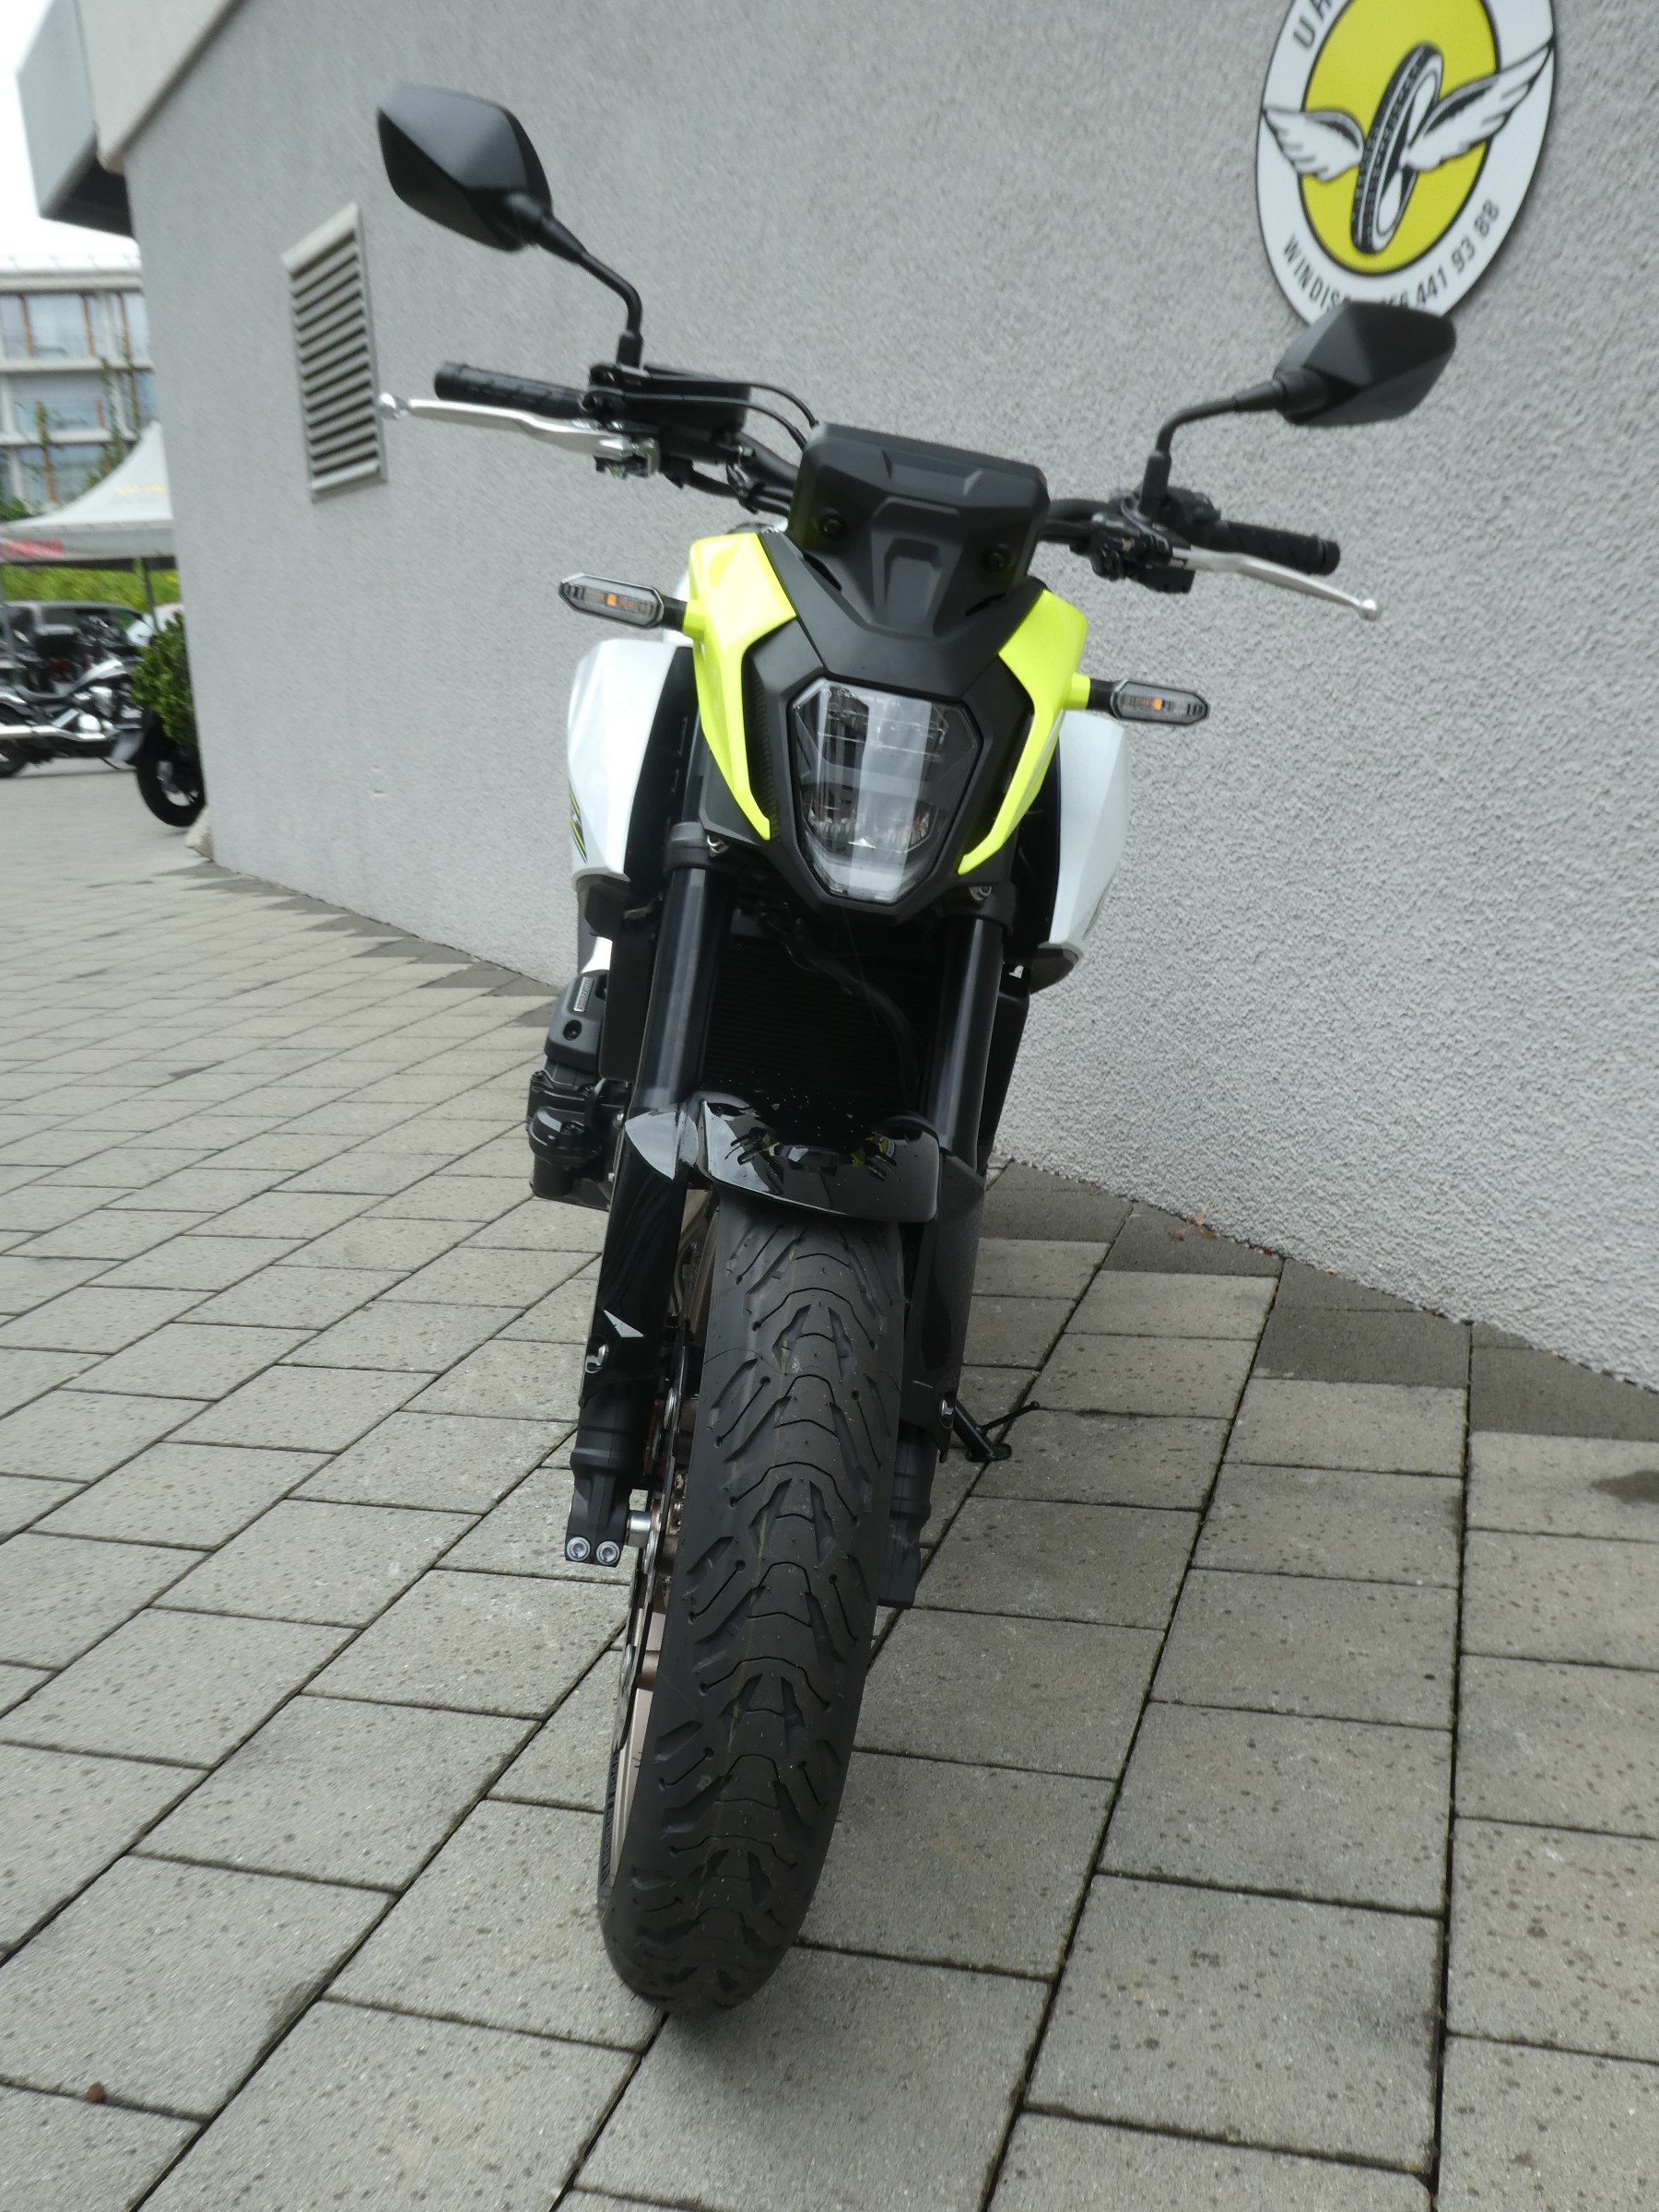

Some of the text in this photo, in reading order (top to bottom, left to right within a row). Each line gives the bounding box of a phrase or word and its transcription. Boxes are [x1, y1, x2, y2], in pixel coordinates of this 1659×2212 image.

[1284, 233, 1346, 311] WINDIS
[1417, 199, 1499, 309] 441 93 88
